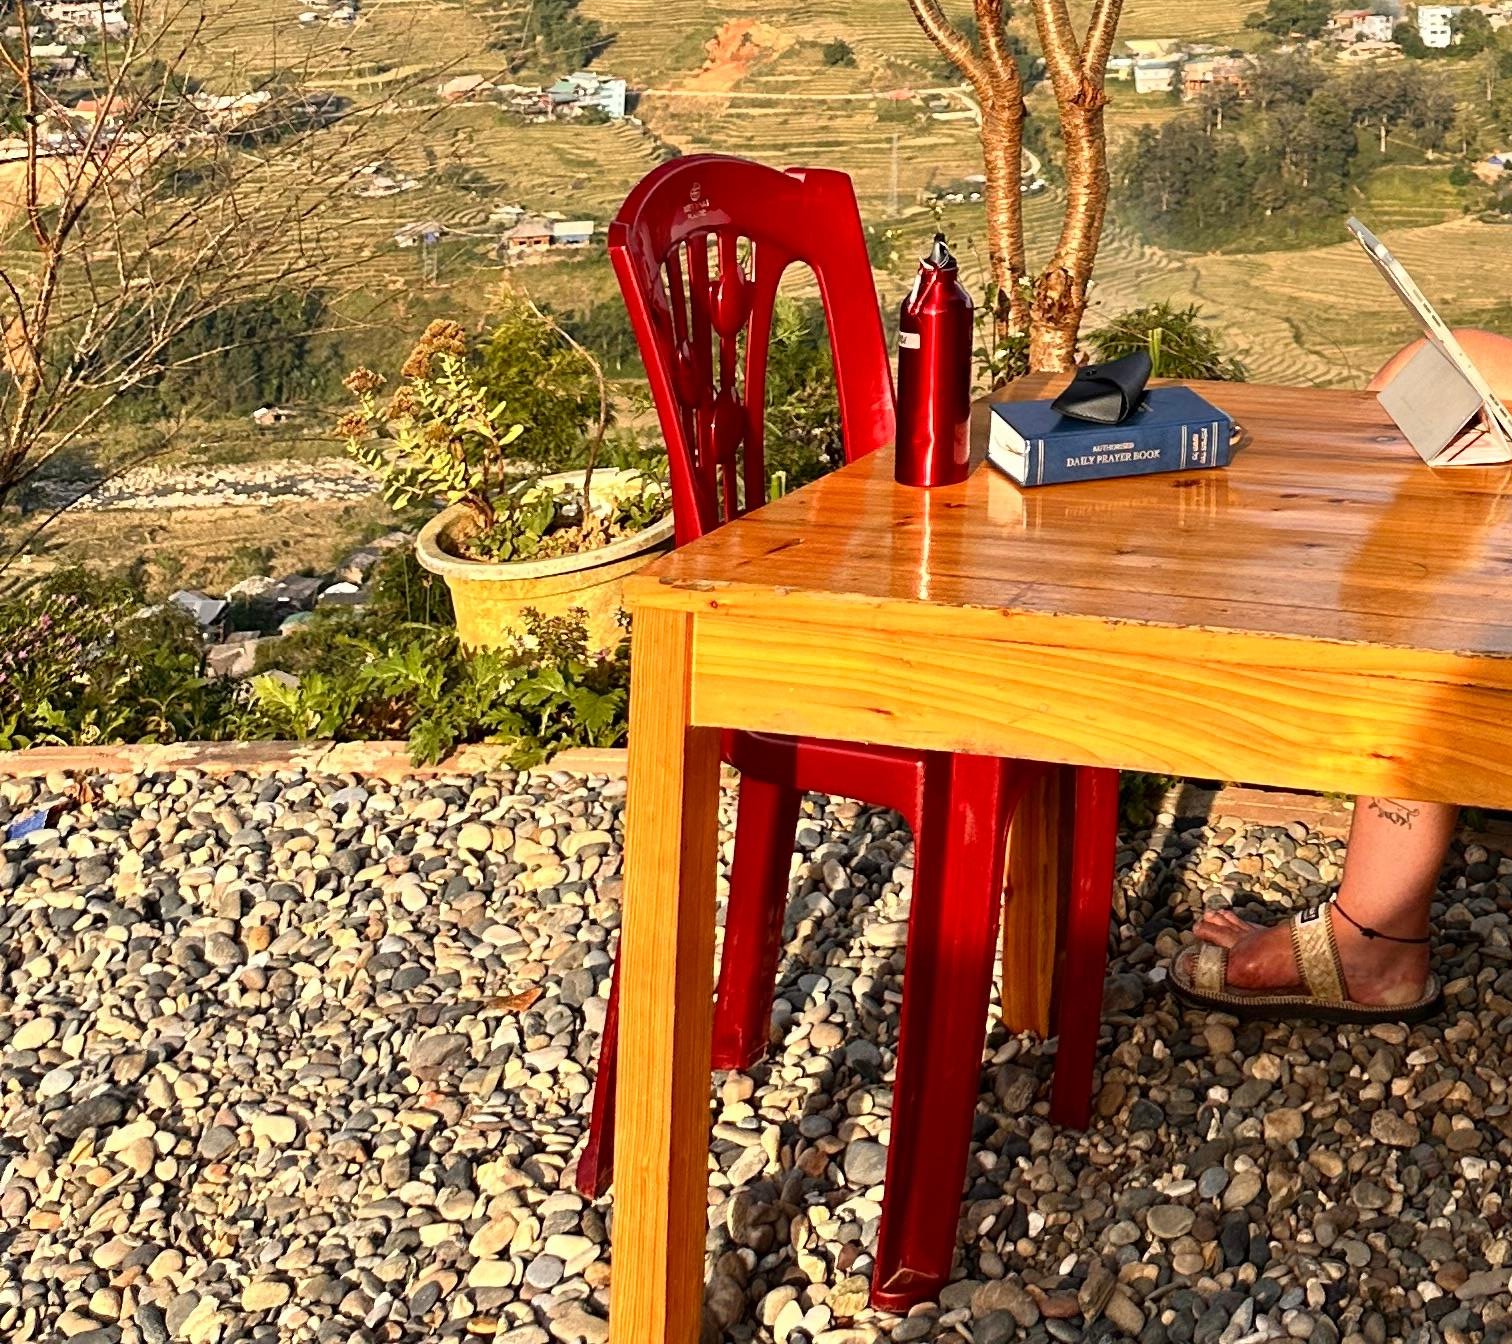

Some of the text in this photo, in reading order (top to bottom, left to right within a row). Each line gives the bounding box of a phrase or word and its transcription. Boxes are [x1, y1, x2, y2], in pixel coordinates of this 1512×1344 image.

[1066, 448, 1161, 467] DAILY PRAYER BOOK
